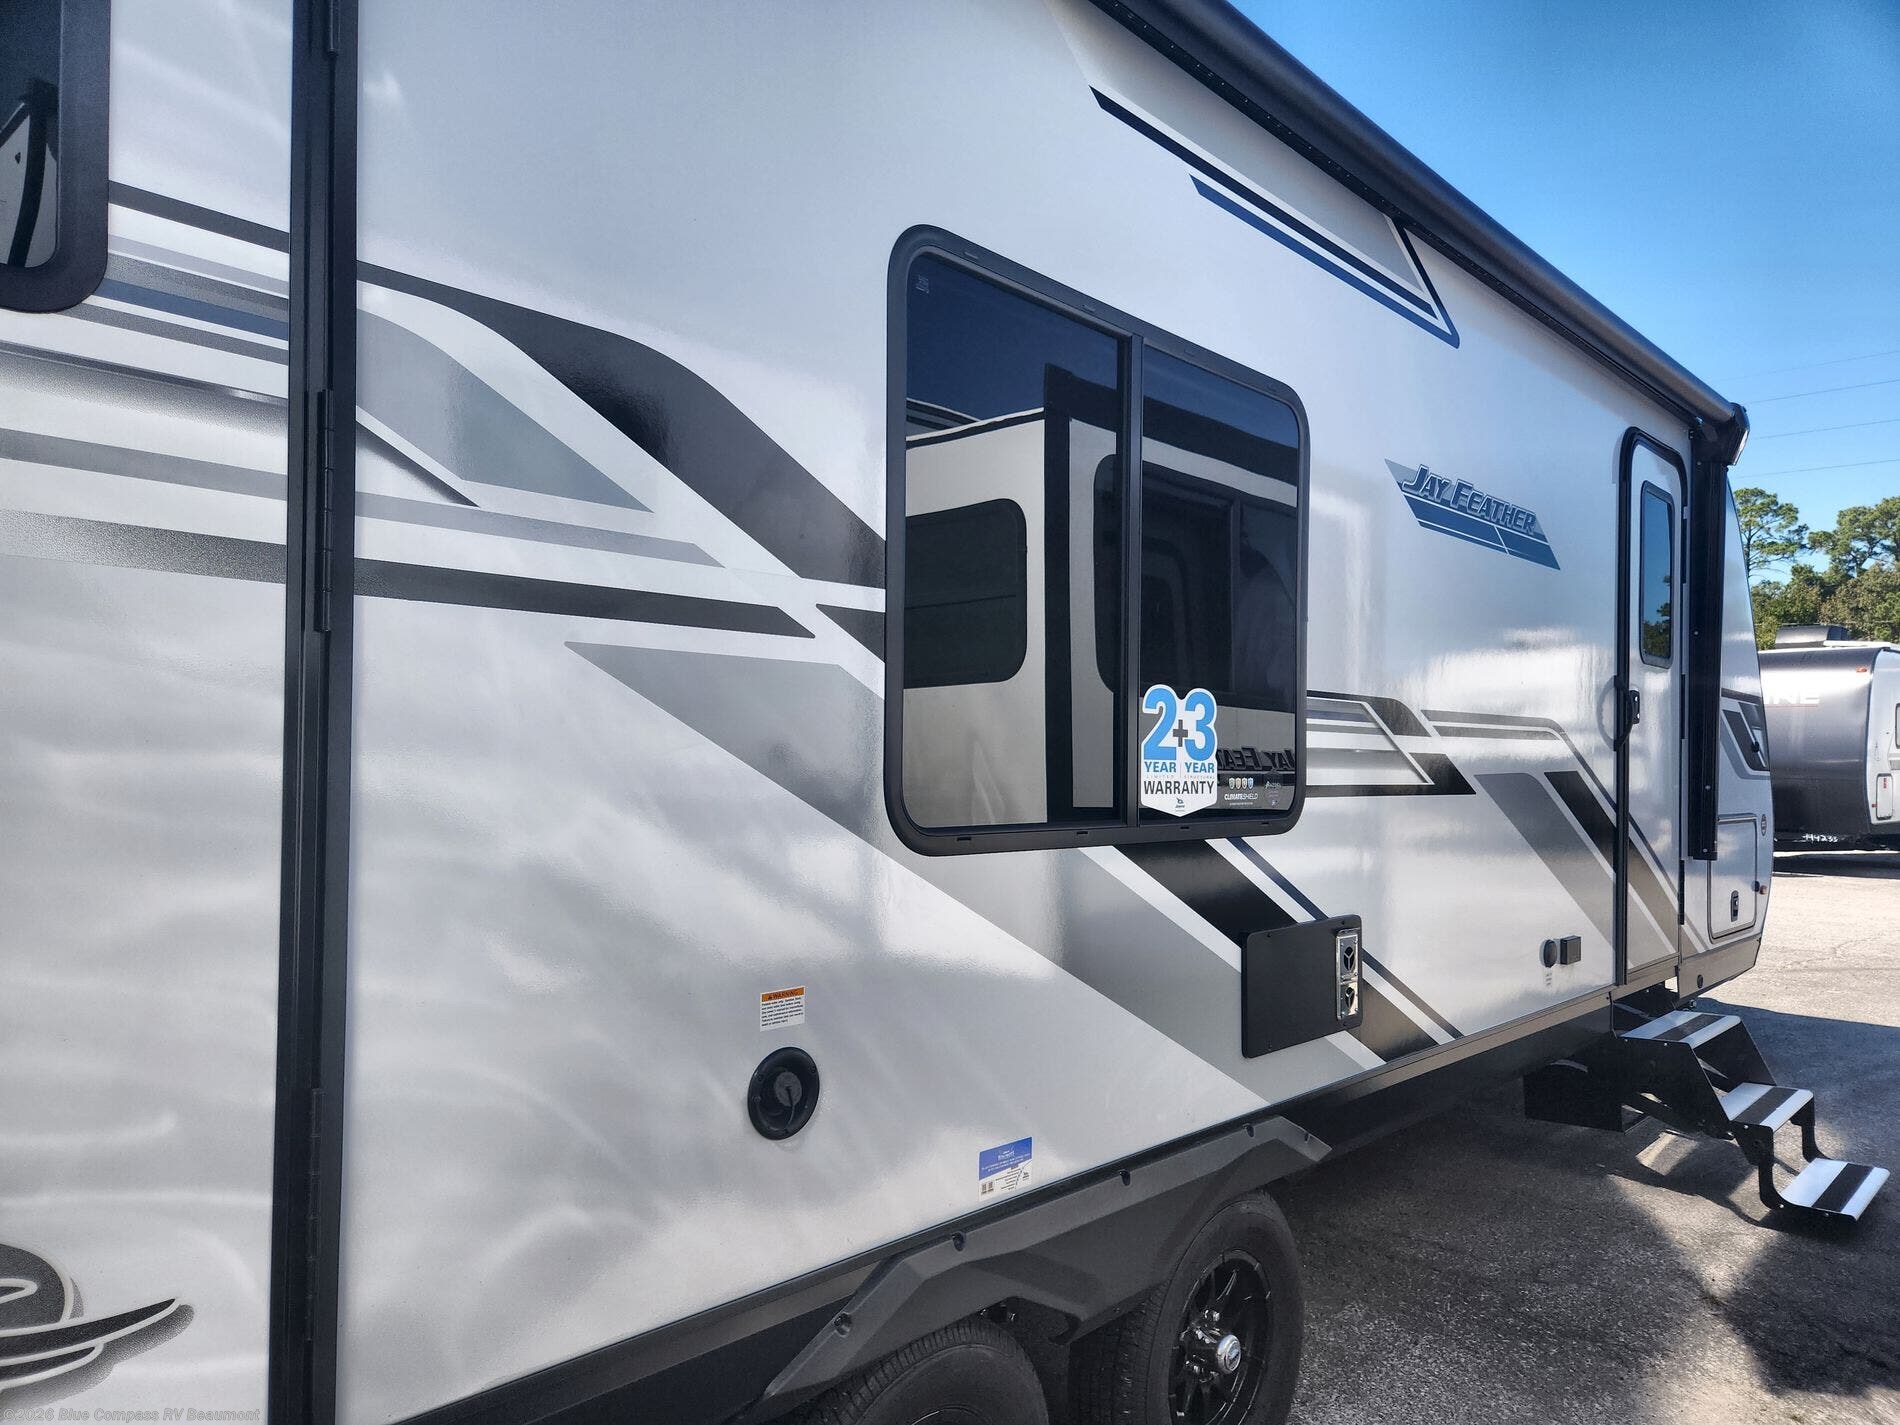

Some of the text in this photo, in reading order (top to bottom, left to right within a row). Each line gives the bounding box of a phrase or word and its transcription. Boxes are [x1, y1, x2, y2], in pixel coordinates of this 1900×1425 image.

[1402, 464, 1538, 535] JAY FEATHER
[1144, 761, 1177, 773] YEAR
[1184, 762, 1215, 773] YEAR
[1143, 780, 1215, 795] WARRANTY
